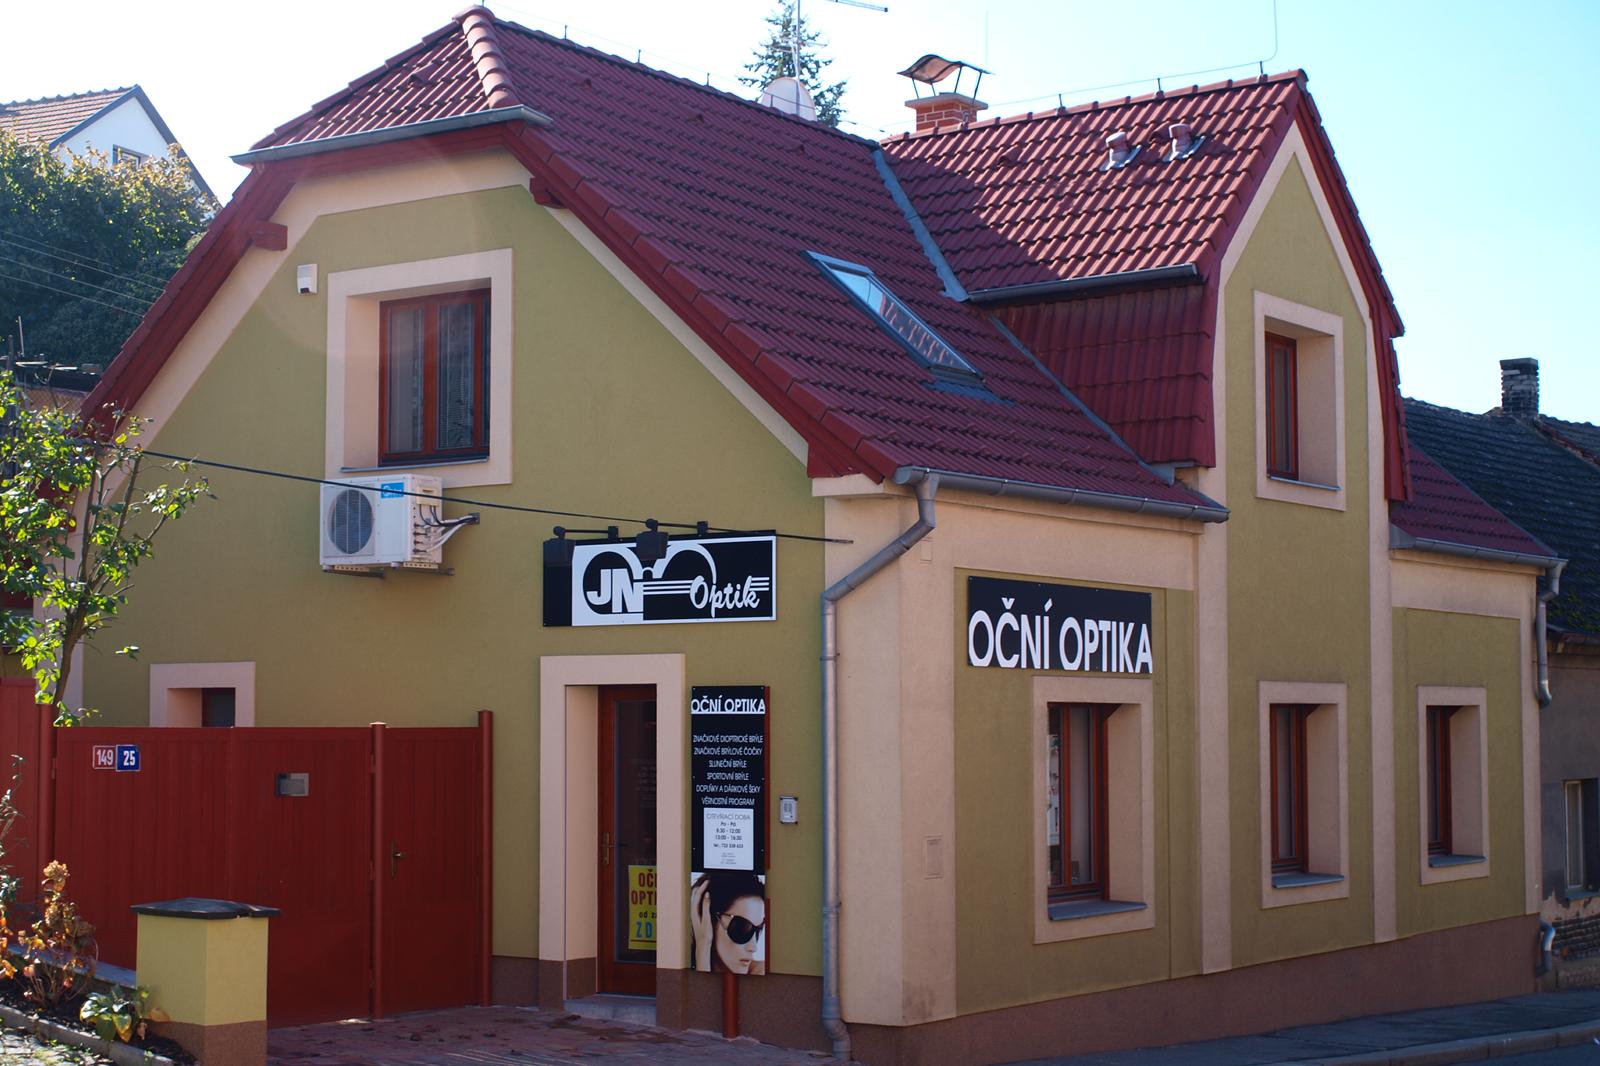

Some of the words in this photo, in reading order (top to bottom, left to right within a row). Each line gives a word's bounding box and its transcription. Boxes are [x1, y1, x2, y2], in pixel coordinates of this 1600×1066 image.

[586, 568, 643, 613] JN
[689, 575, 760, 618] Optik
[968, 597, 1053, 670] OČNÍ
[1059, 616, 1153, 674] OPTIKA
[691, 694, 723, 713] OČNÍ
[724, 698, 766, 713] OPTIKA
[693, 734, 720, 743] ZNAČKOVÉ
[720, 734, 748, 743] DIOPTRICKÉ
[749, 734, 764, 743] BRÝLE
[694, 746, 721, 755] ZNAČKOVÉ
[721, 746, 743, 755] BRÝLOVÉ
[743, 746, 763, 756] ČOČKY
[96, 749, 114, 766] 149
[123, 750, 136, 766] 25
[708, 759, 732, 768] SLUNEČNÍ
[732, 759, 747, 768] BRÝLE
[706, 771, 734, 780] SPORTOVNÍ
[735, 771, 749, 781] BRÝLE
[696, 783, 719, 793] DOPLŇKY
[719, 785, 724, 793] A
[724, 784, 748, 793] DÁRKOVÉ
[748, 784, 761, 793] ŠEKY
[701, 795, 728, 805] VĚRNOSTNÍ
[728, 797, 755, 806] PROGRAM
[639, 911, 648, 919] od
